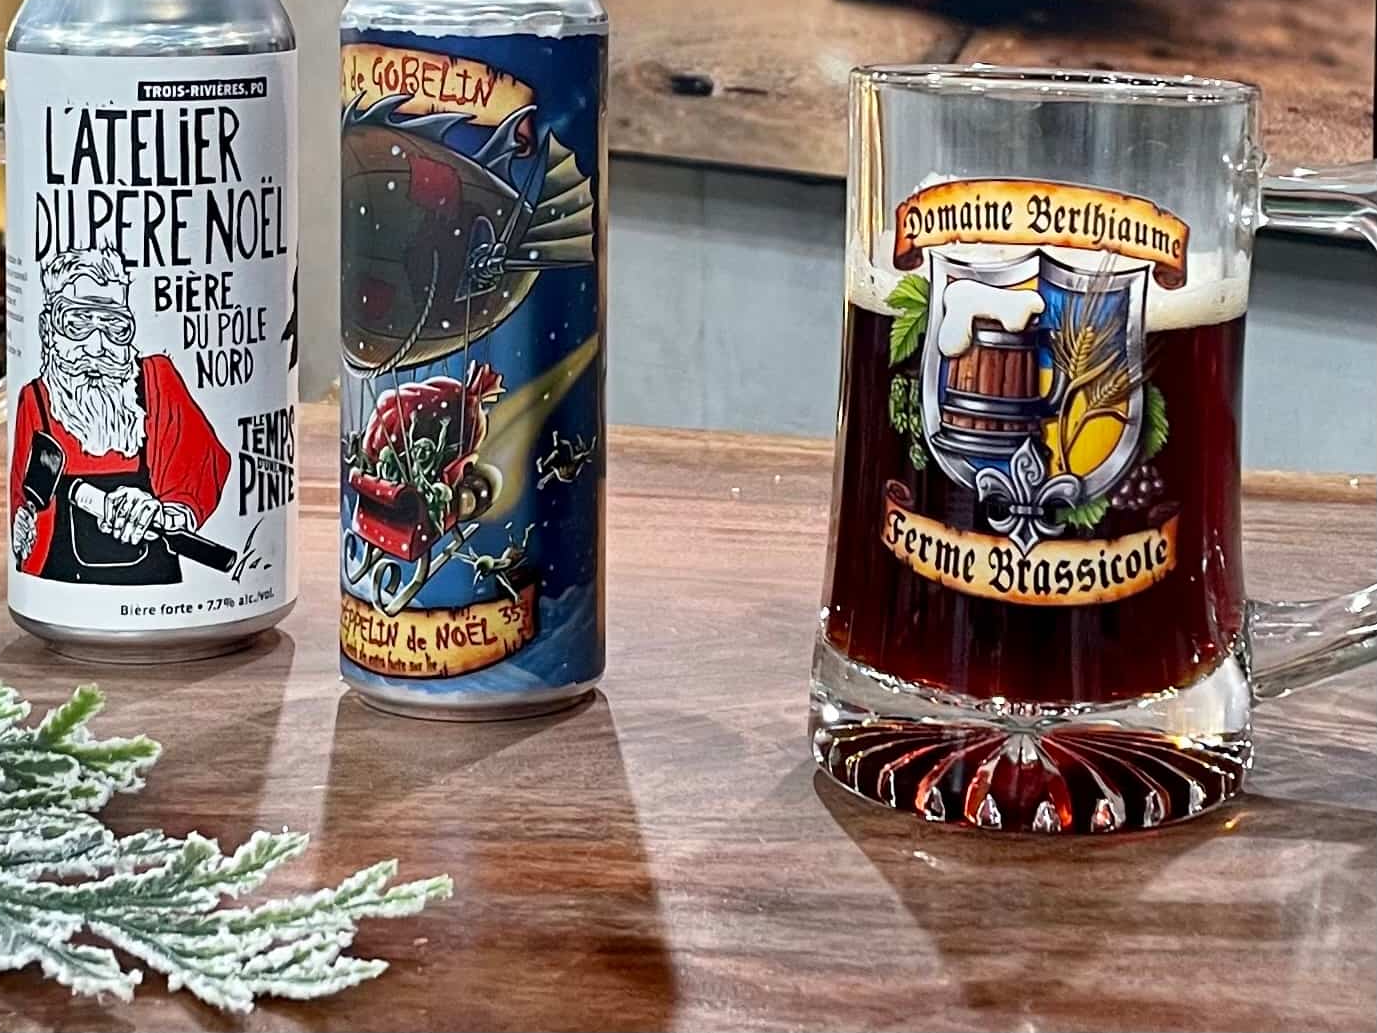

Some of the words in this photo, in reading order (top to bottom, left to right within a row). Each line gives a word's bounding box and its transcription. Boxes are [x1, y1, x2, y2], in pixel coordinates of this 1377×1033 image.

[372, 54, 497, 108] GOBELIN
[205, 176, 288, 265] NOËL
[904, 194, 1013, 240] Domaine
[1026, 193, 1182, 260] Berthiaume
[183, 313, 209, 350] DU
[218, 303, 268, 347] PÔLE
[196, 347, 255, 389] NORD
[238, 404, 295, 465] TEMPS
[239, 450, 295, 518] PINTE
[886, 509, 976, 584] Ferme
[987, 536, 1169, 595] Brassicole
[119, 603, 157, 616] Bière
[160, 601, 193, 615] forte
[406, 624, 427, 654] de
[435, 614, 498, 651] NOËL
